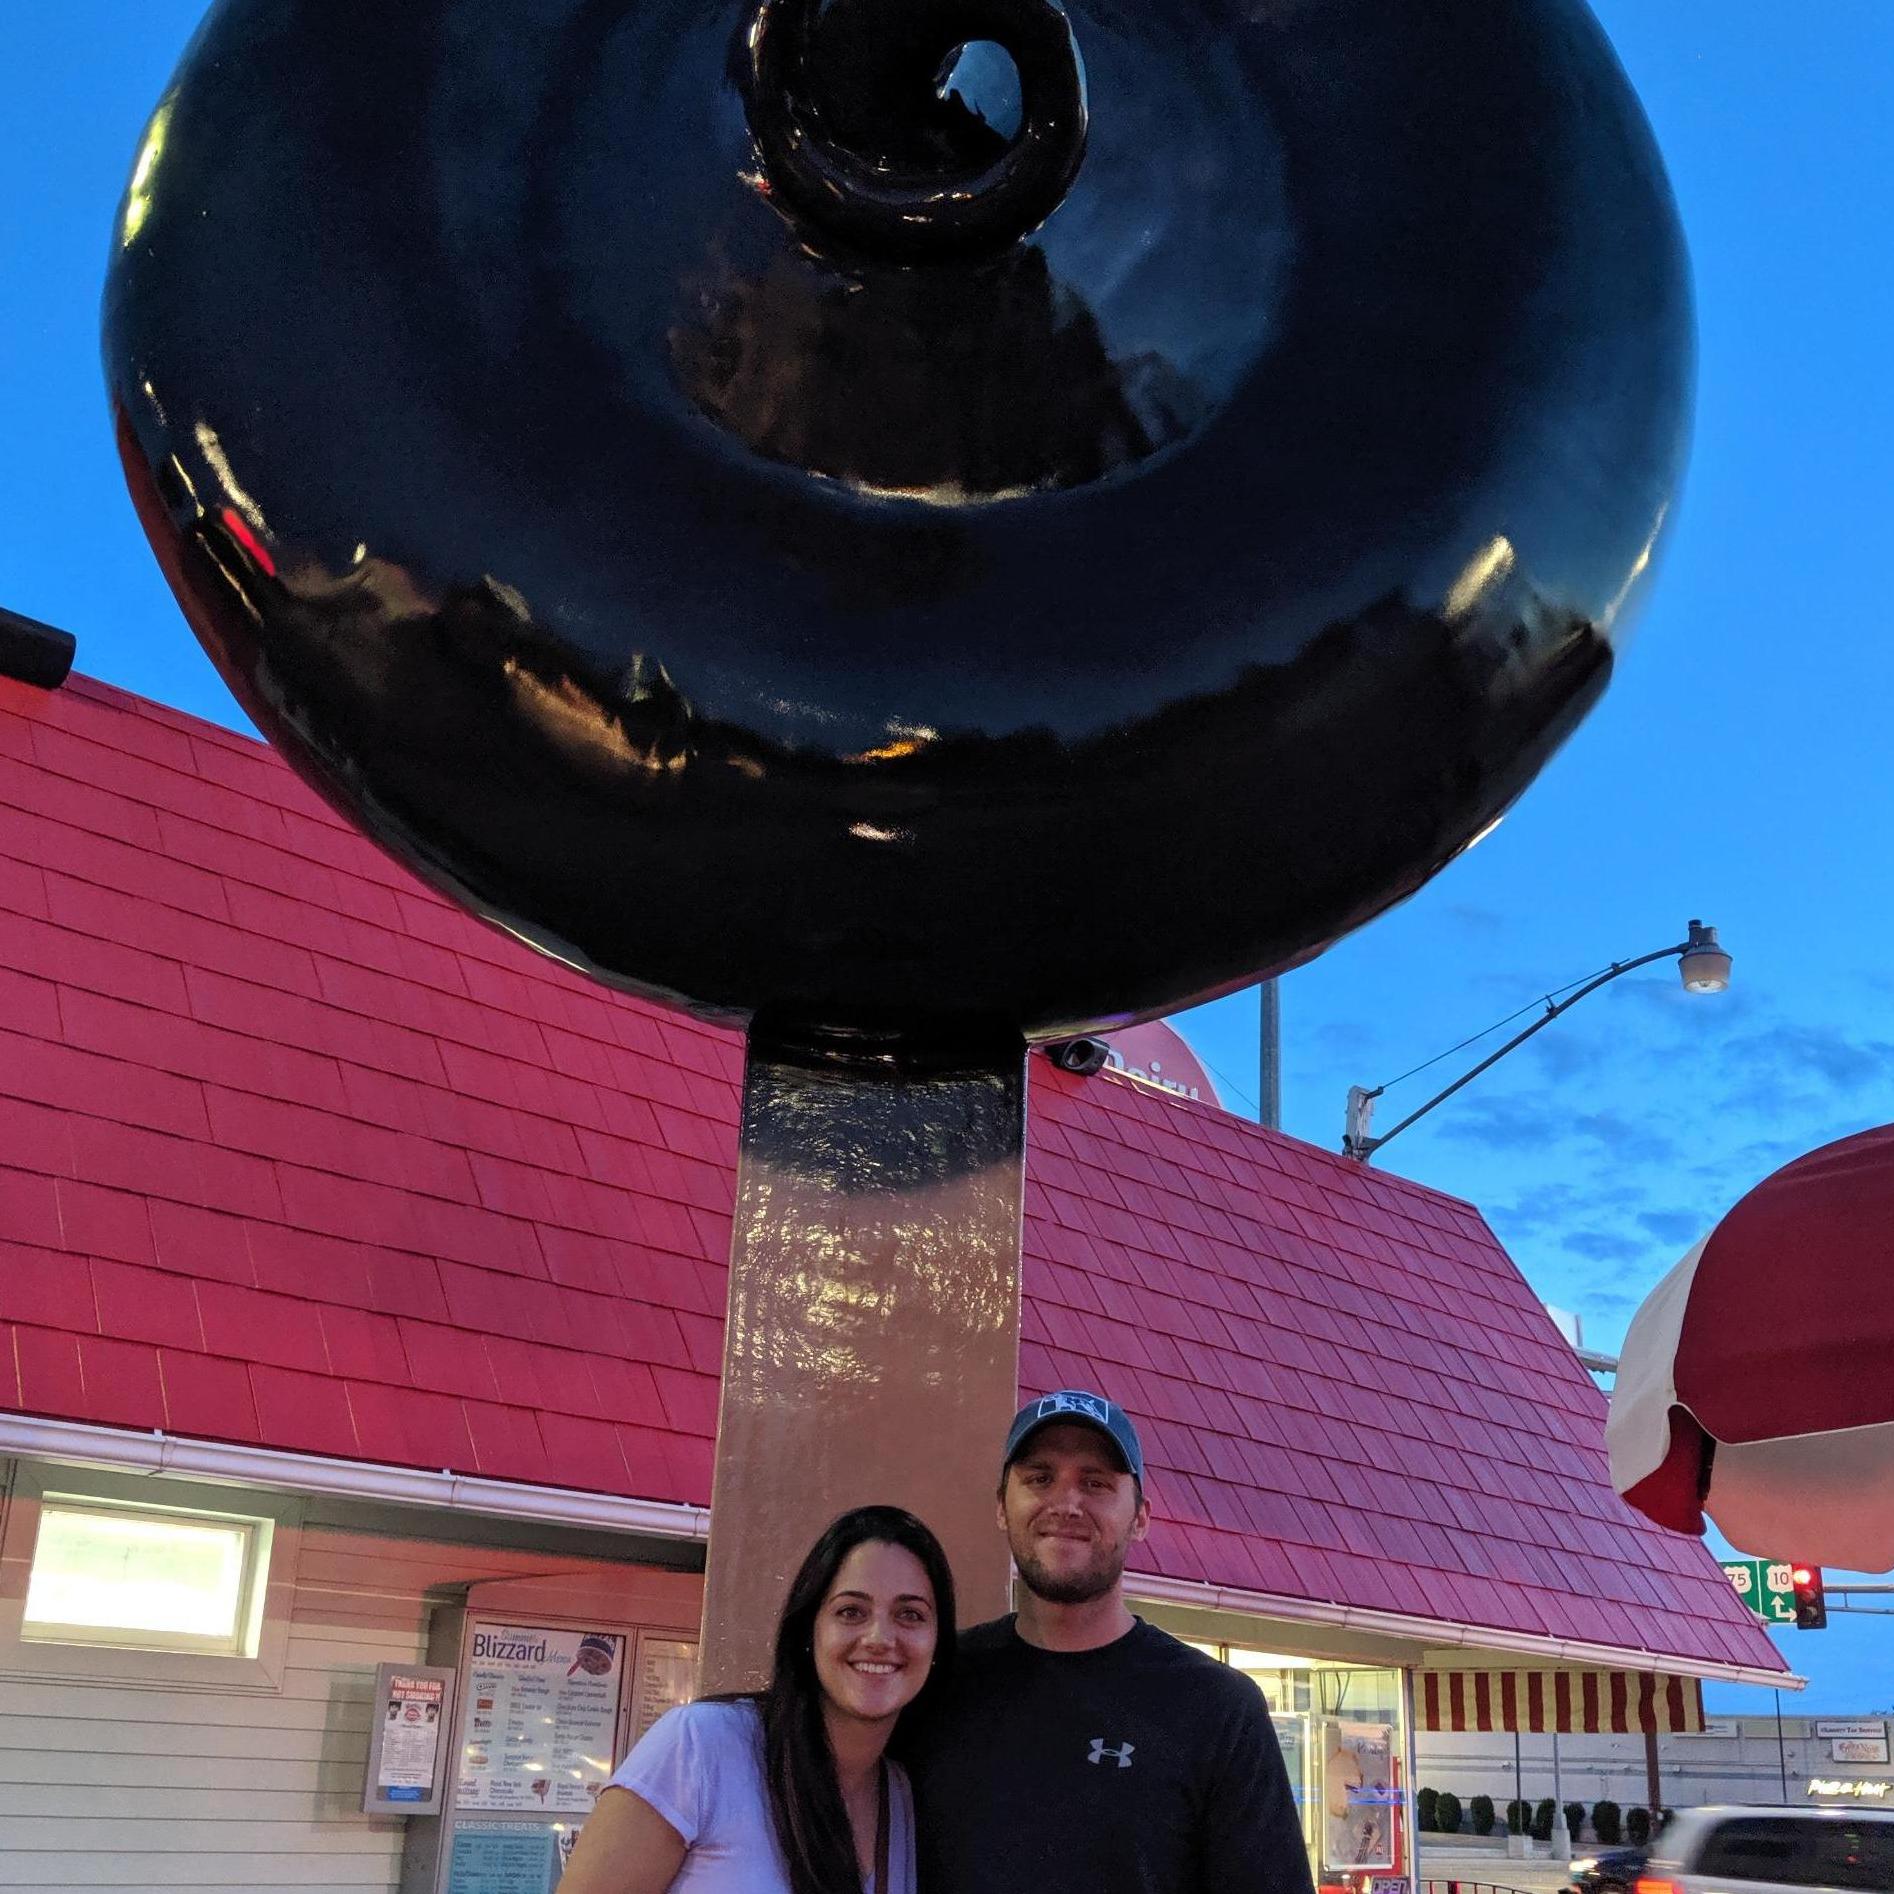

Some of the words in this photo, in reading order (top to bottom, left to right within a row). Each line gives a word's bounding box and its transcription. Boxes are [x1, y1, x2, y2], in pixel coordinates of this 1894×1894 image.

[1774, 1572, 1789, 1585] 10
[473, 1633, 547, 1663] Blizzard
[454, 1821, 498, 1830] CLASSIC
[500, 1822, 541, 1832] TREATS
